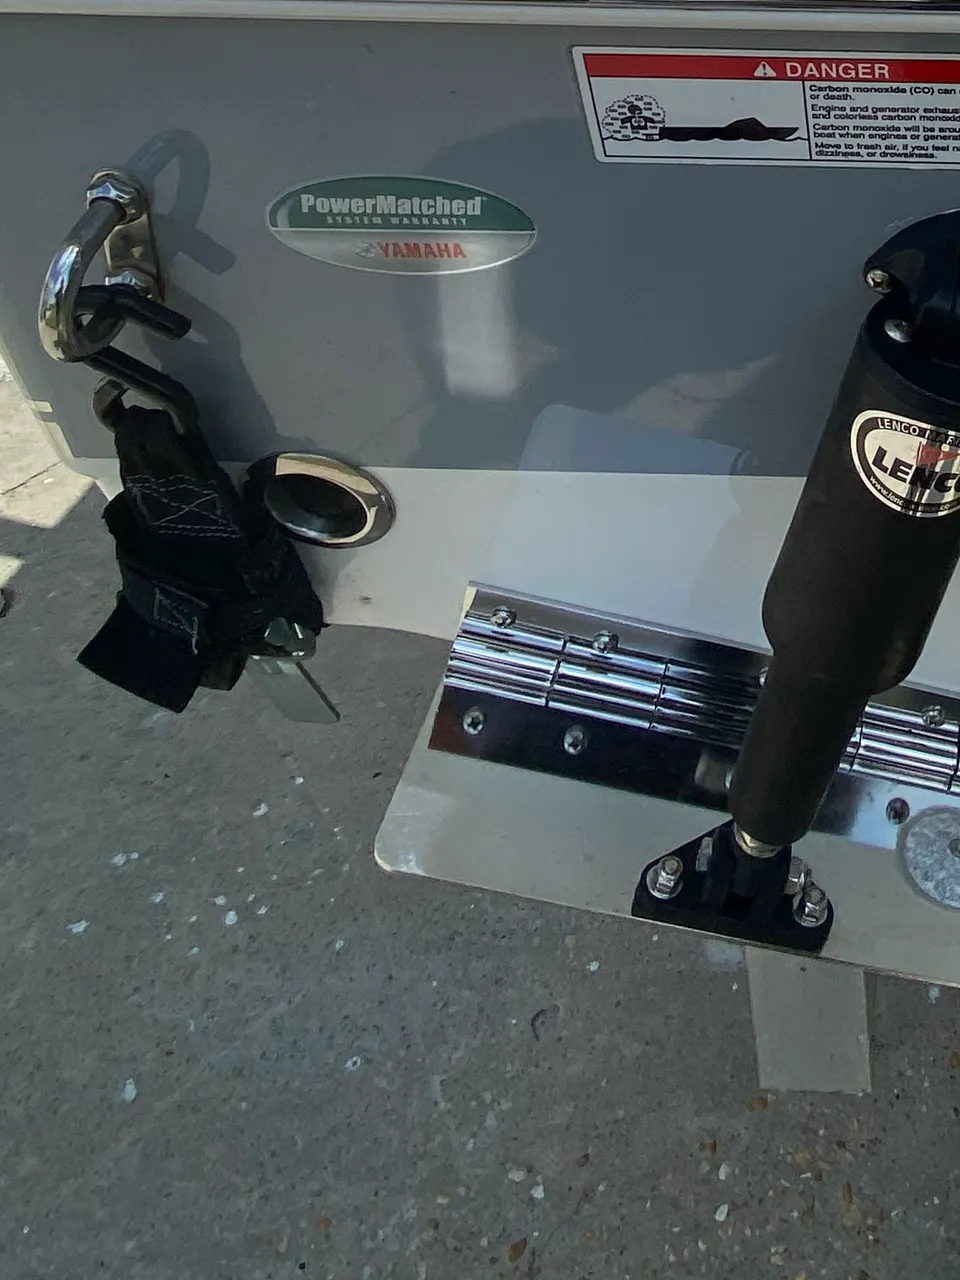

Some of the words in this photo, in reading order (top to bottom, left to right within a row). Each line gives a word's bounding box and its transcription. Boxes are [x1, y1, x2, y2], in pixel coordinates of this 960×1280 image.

[785, 62, 890, 79] DANGER
[809, 84, 849, 93] Carbon
[852, 85, 907, 94] monoxide
[909, 86, 935, 96] (CO)
[811, 104, 846, 113] Engine
[871, 106, 920, 114] generator
[812, 112, 830, 120] and
[881, 113, 916, 121] carbon
[813, 123, 849, 131] Carbon
[853, 124, 901, 132] monoxide
[922, 125, 936, 133] be
[813, 131, 836, 139] boat
[838, 131, 865, 139] when
[868, 132, 908, 140] engines
[814, 142, 841, 150] Move
[844, 142, 854, 150] to
[857, 142, 881, 150] fresh
[911, 145, 929, 153] you
[931, 144, 949, 152] feel
[300, 194, 482, 215] PowerMatched
[391, 217, 467, 225] WARRANTY
[377, 242, 466, 258] YAMAHA
[877, 418, 920, 436] LENCO
